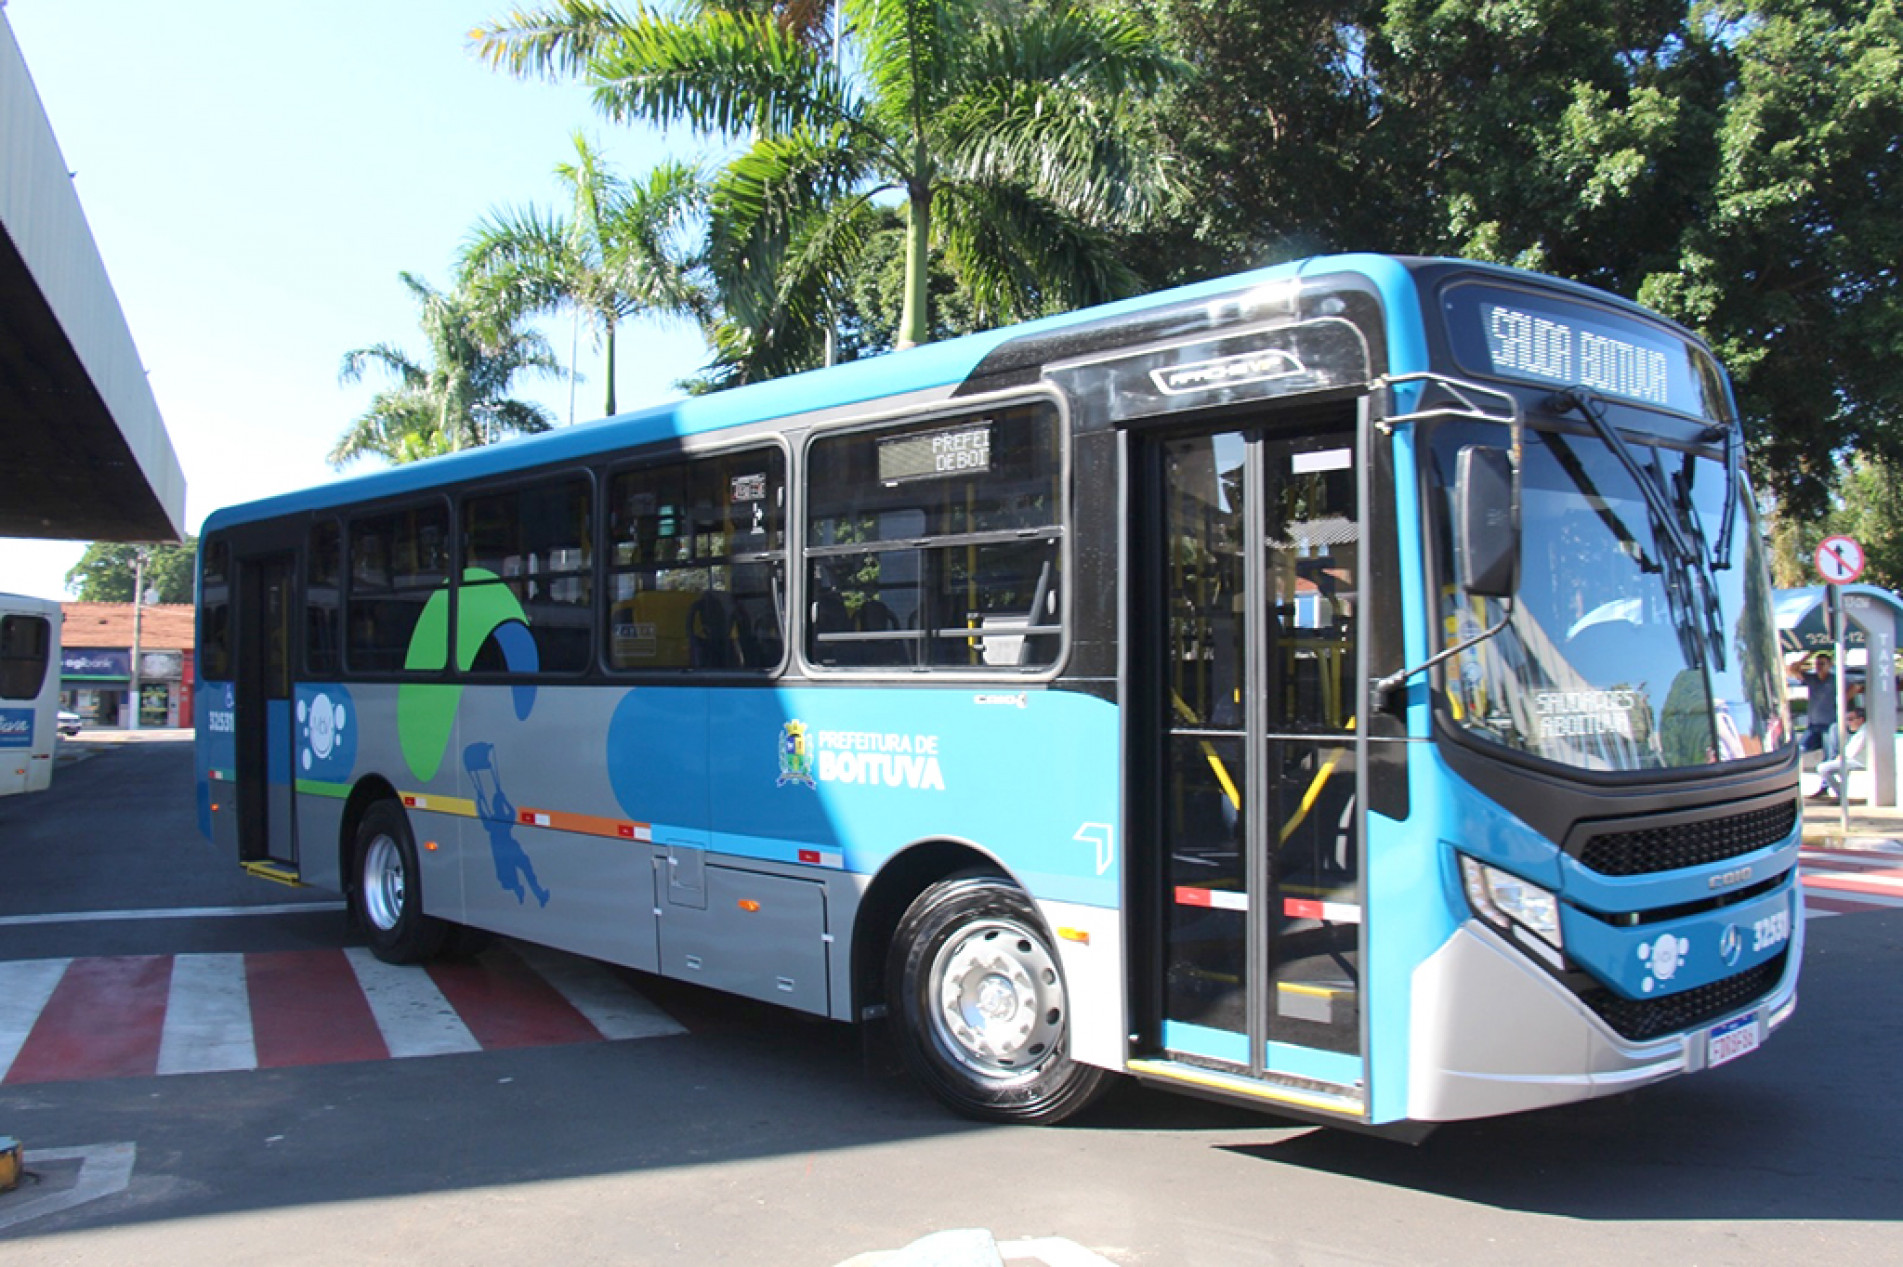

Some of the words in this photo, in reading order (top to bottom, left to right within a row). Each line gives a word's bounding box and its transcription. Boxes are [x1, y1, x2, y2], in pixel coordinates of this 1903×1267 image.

[818, 731, 912, 753] PREFEITURA
[915, 734, 939, 755] DE
[819, 751, 945, 790] BOITUVA
